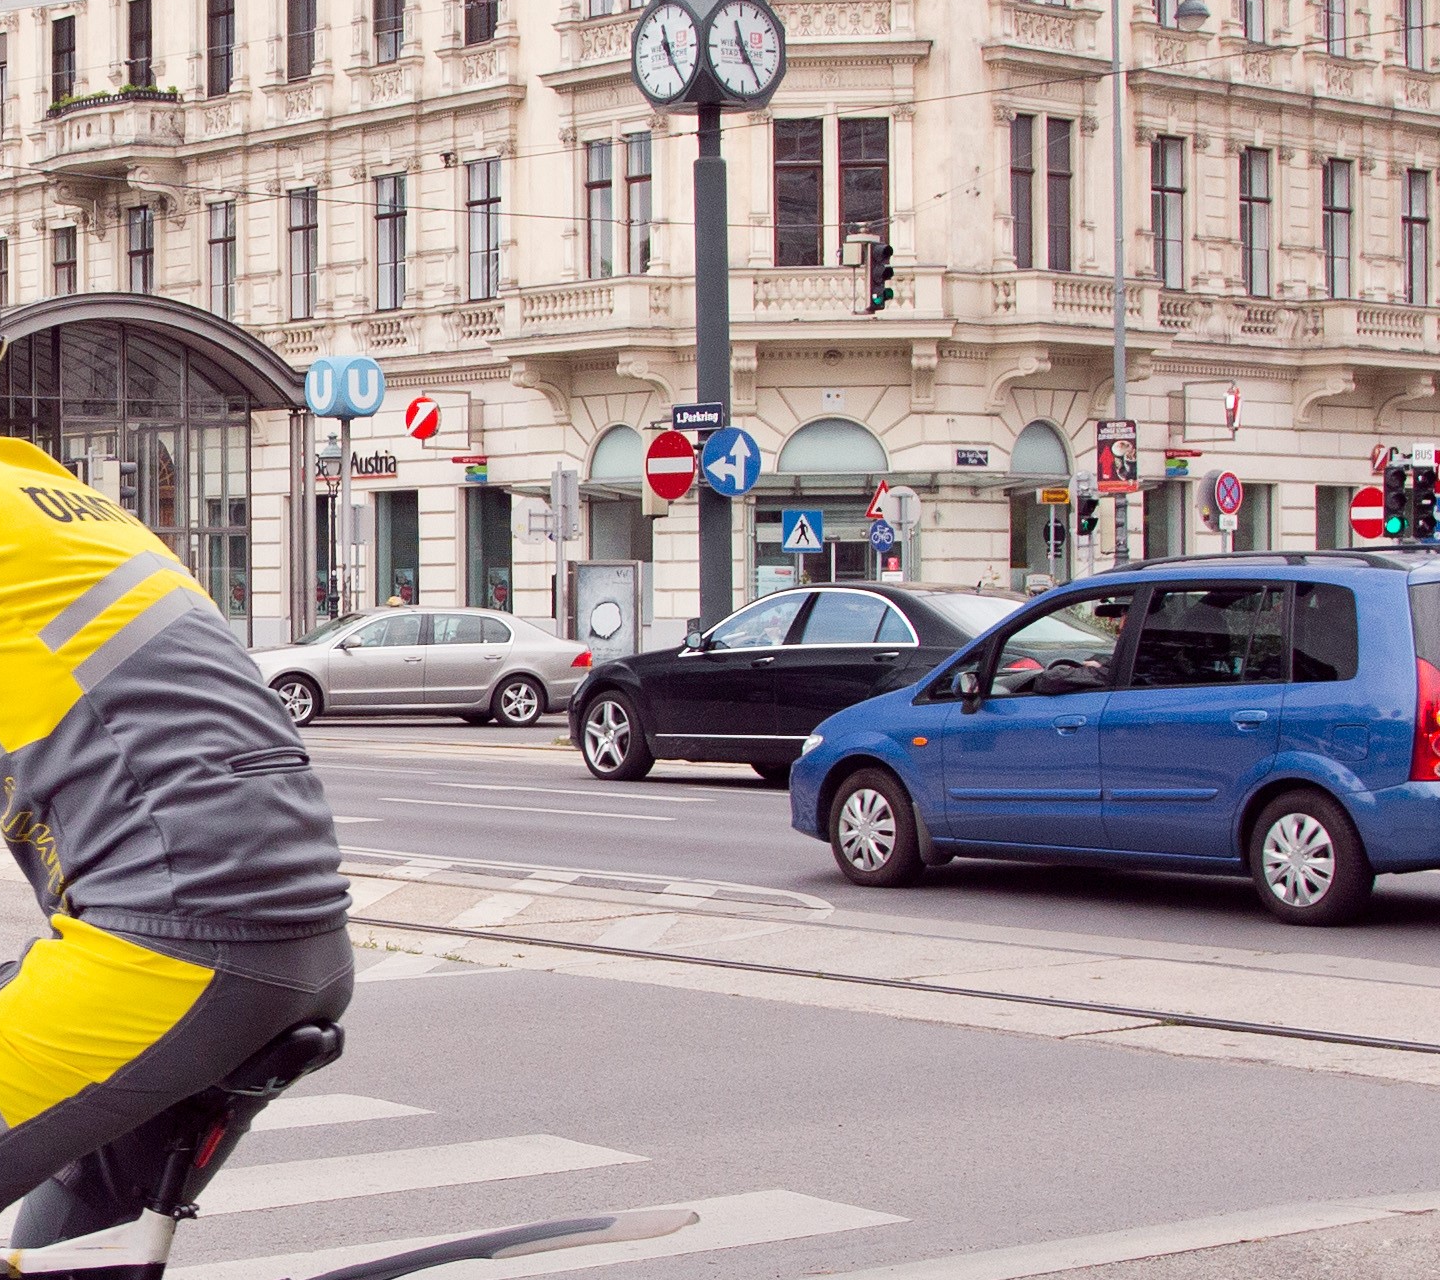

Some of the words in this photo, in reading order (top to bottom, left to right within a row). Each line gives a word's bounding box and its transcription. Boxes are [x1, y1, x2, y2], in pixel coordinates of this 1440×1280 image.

[308, 369, 333, 411] U
[347, 368, 379, 410] U
[350, 449, 398, 475] Austria
[1414, 449, 1433, 460] BUS
